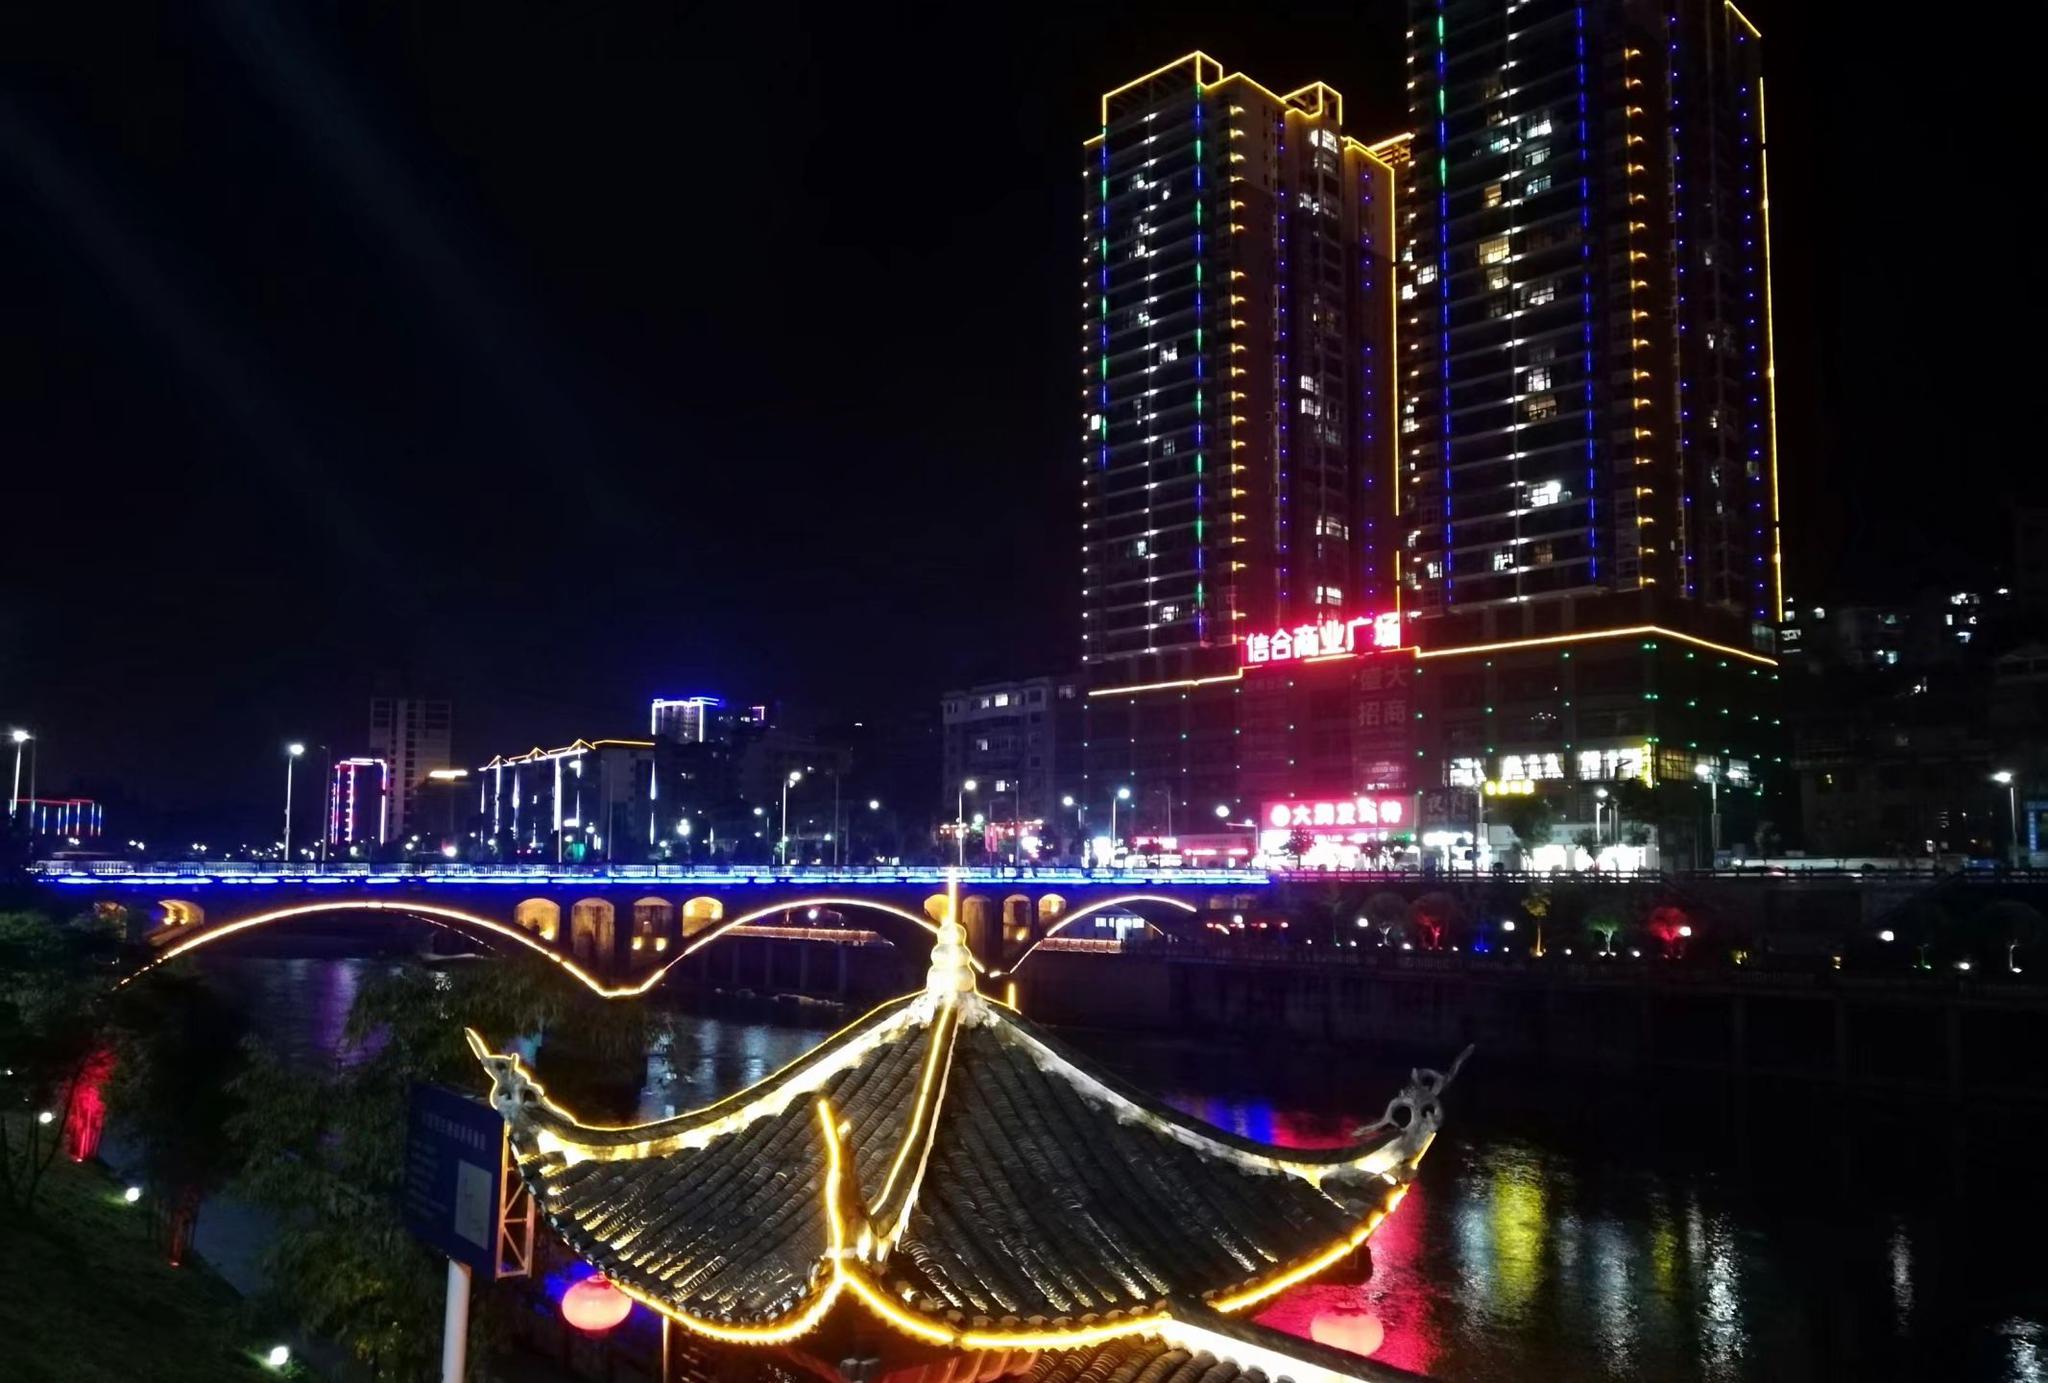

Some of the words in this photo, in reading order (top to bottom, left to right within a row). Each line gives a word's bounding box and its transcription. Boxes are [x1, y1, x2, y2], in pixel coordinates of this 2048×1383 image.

[1246, 612, 1400, 663] 信合商业广场
